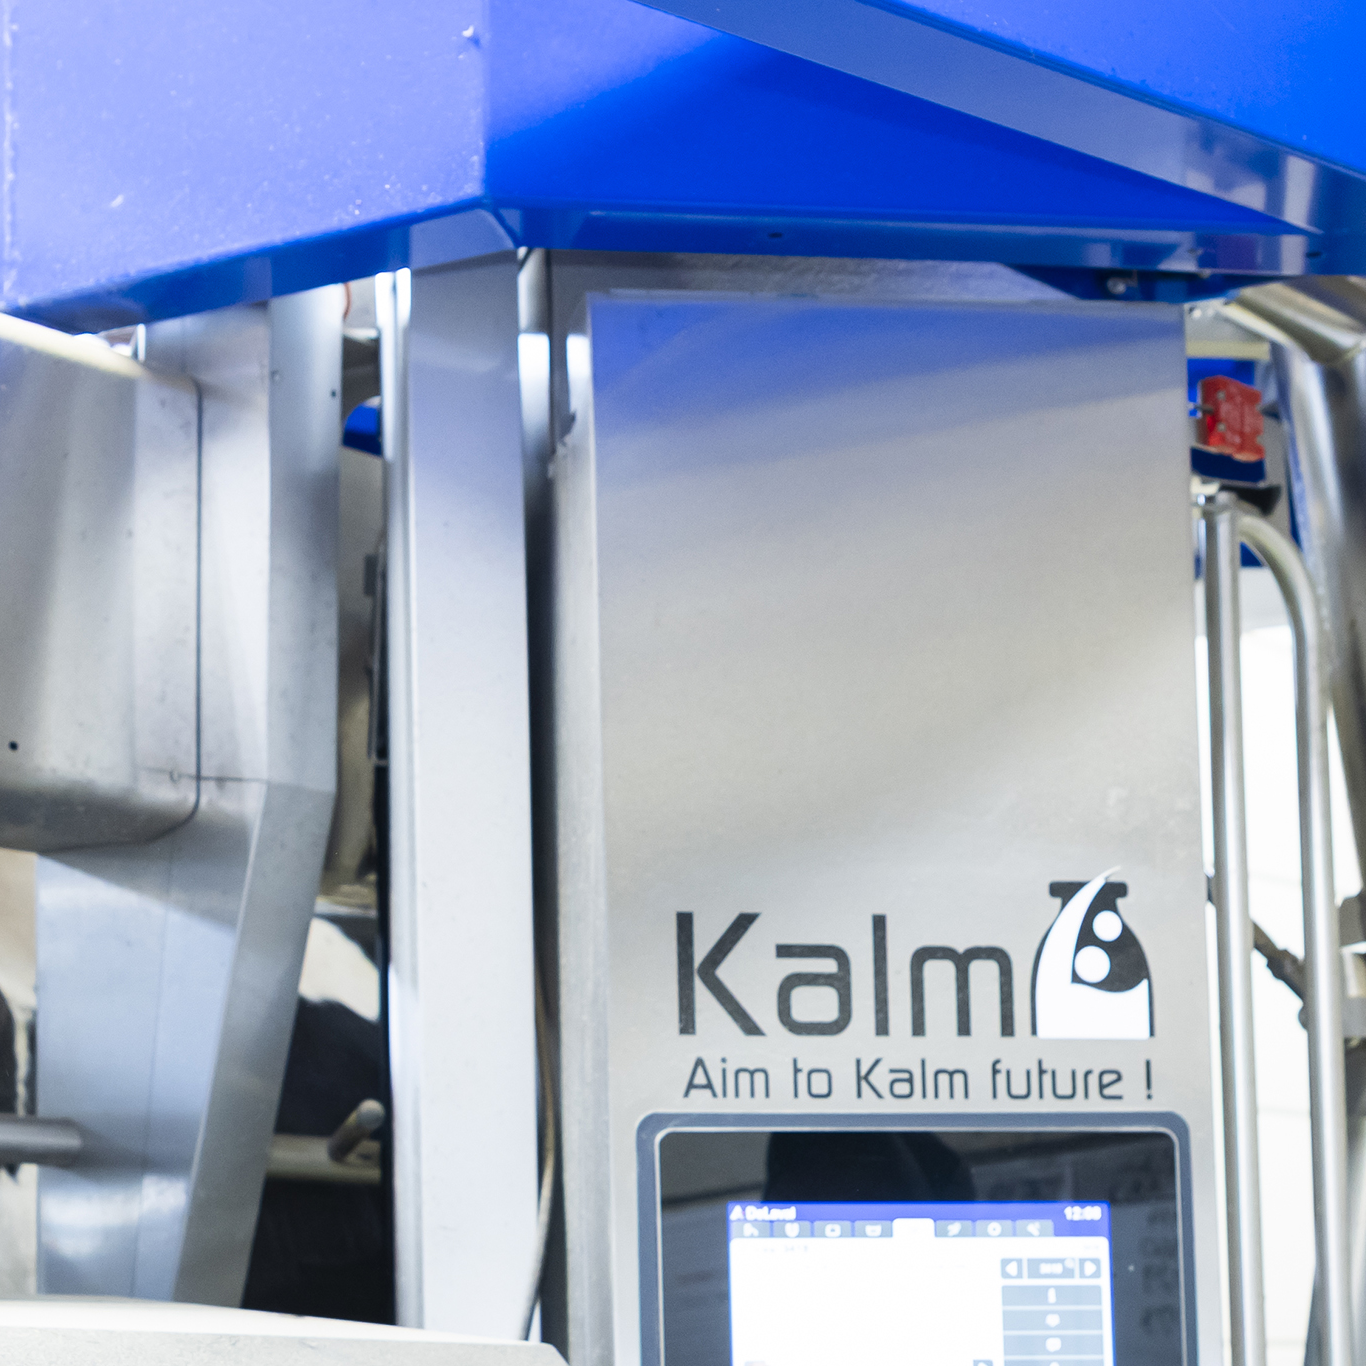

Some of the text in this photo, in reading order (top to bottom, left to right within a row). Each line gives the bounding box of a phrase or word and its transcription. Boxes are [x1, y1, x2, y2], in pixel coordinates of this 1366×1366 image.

[676, 912, 1014, 1036] Kalm
[683, 1056, 770, 1099] Aim
[793, 1057, 833, 1098] to
[855, 1057, 969, 1100] Kalm
[991, 1059, 1124, 1100] future
